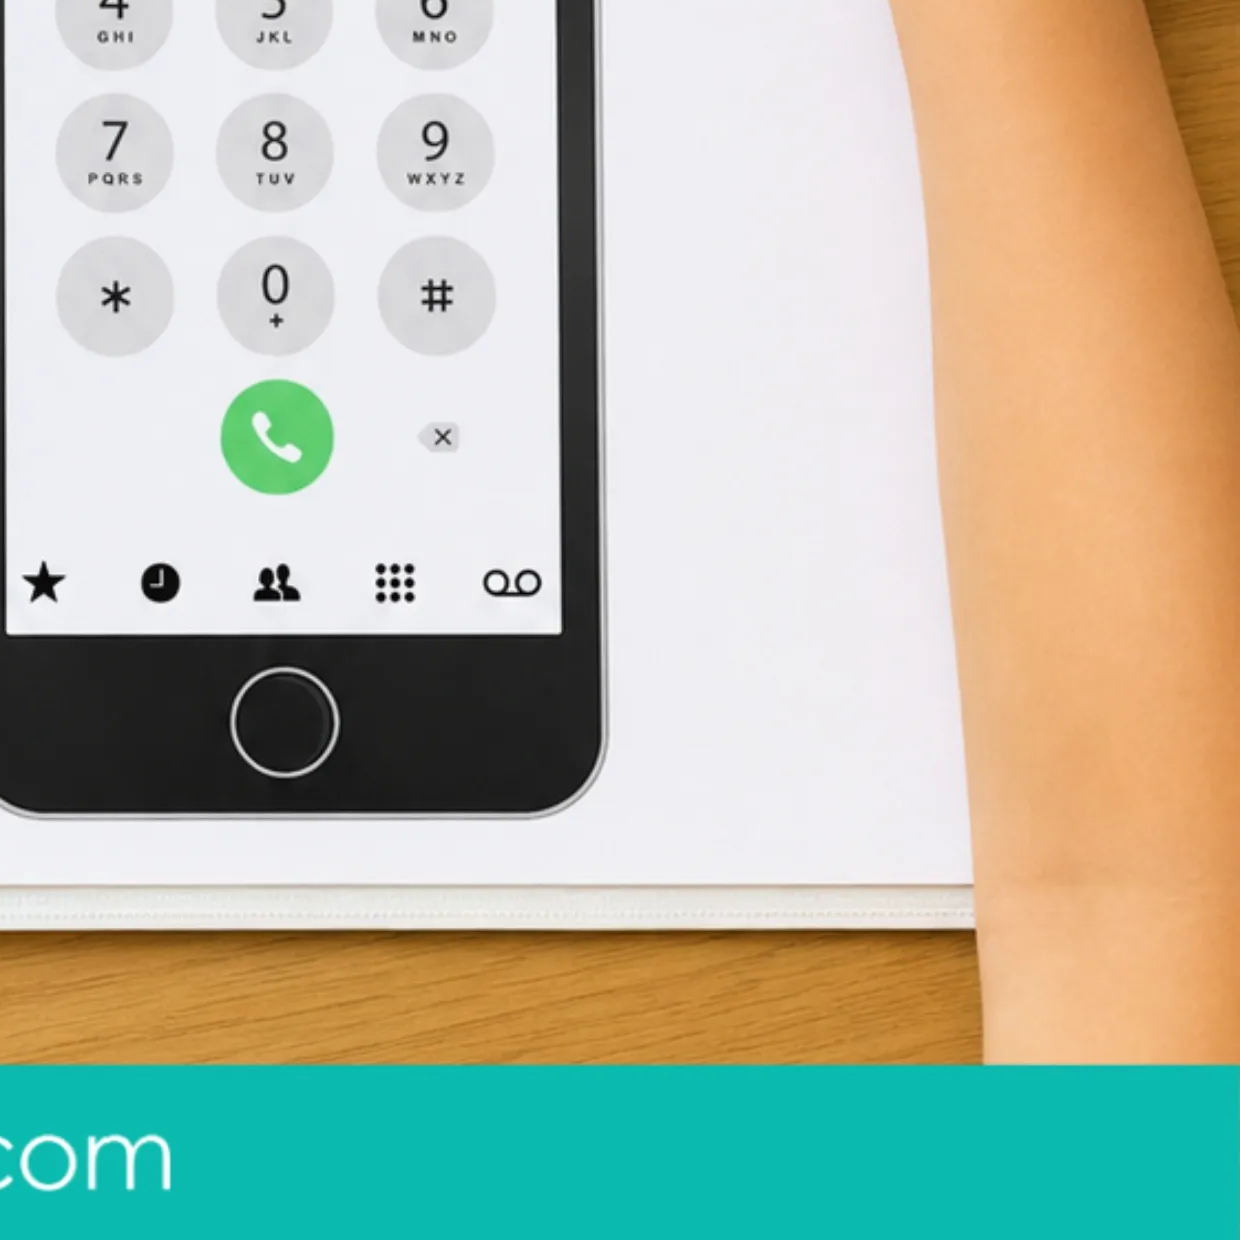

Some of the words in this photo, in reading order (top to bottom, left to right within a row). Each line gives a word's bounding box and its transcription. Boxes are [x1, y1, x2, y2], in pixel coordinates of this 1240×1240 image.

[96, 30, 135, 43] GHI
[256, 31, 293, 43] JKL
[413, 31, 458, 43] MNO
[102, 121, 128, 161] 7
[261, 121, 288, 161] 8
[422, 120, 449, 161] 9
[87, 172, 144, 186] PQRS
[256, 173, 296, 186] TUV
[407, 173, 466, 186] WXYZ
[262, 264, 289, 305] 0
